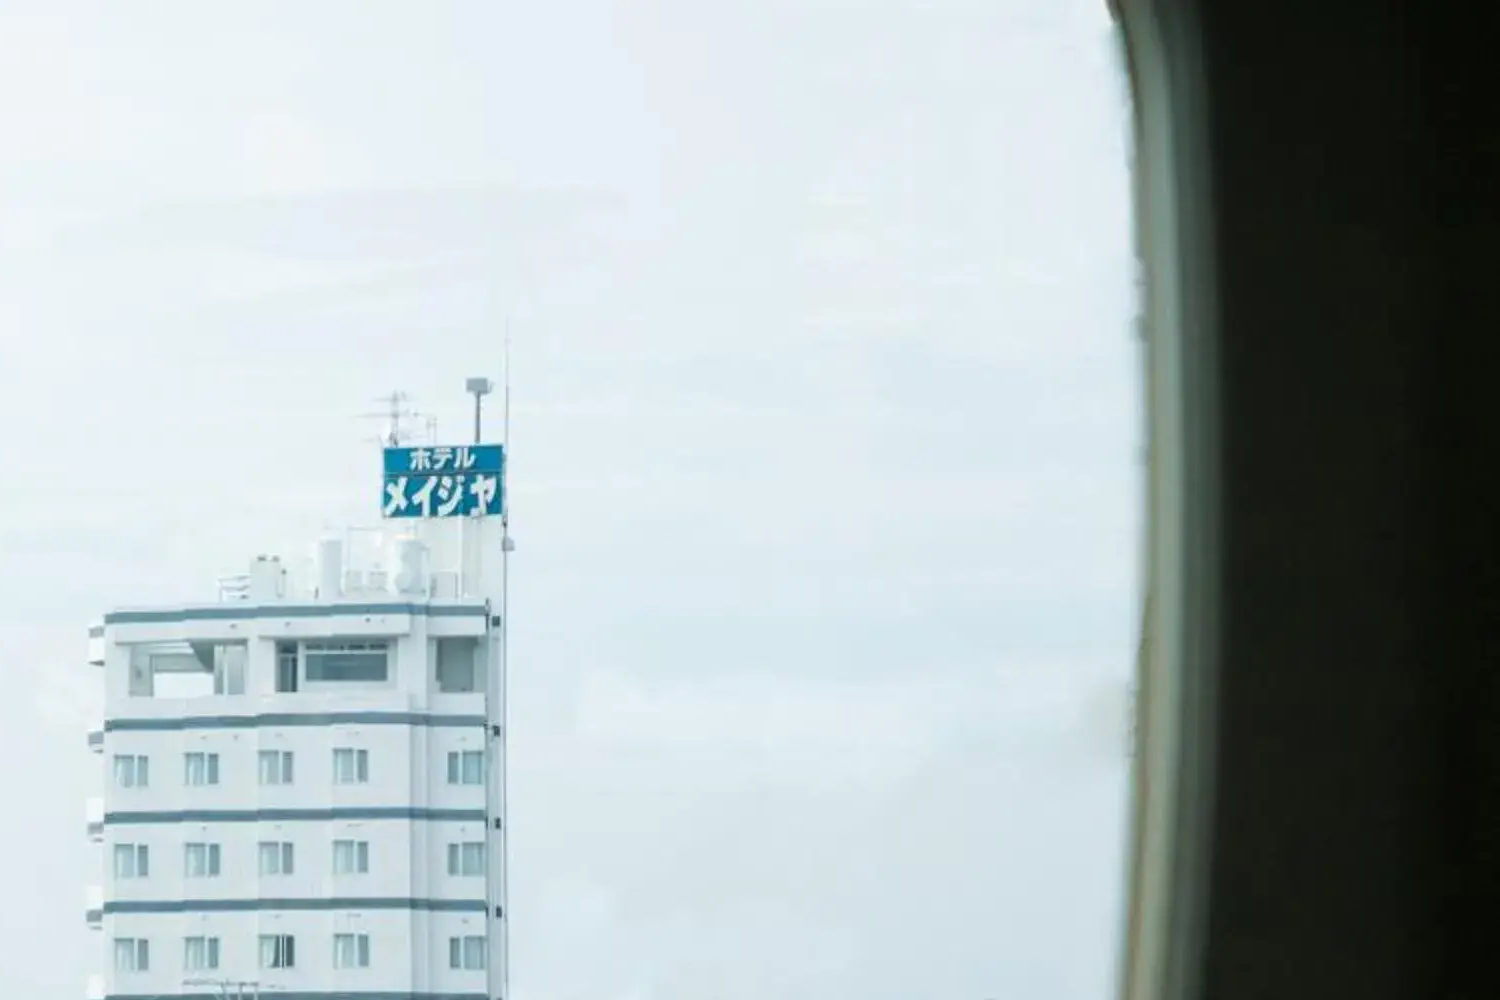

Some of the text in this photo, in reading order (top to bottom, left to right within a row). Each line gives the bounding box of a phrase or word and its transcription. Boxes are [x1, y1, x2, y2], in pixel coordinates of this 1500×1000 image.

[411, 447, 476, 471] ホテル
[385, 474, 497, 517] メイジヤ
